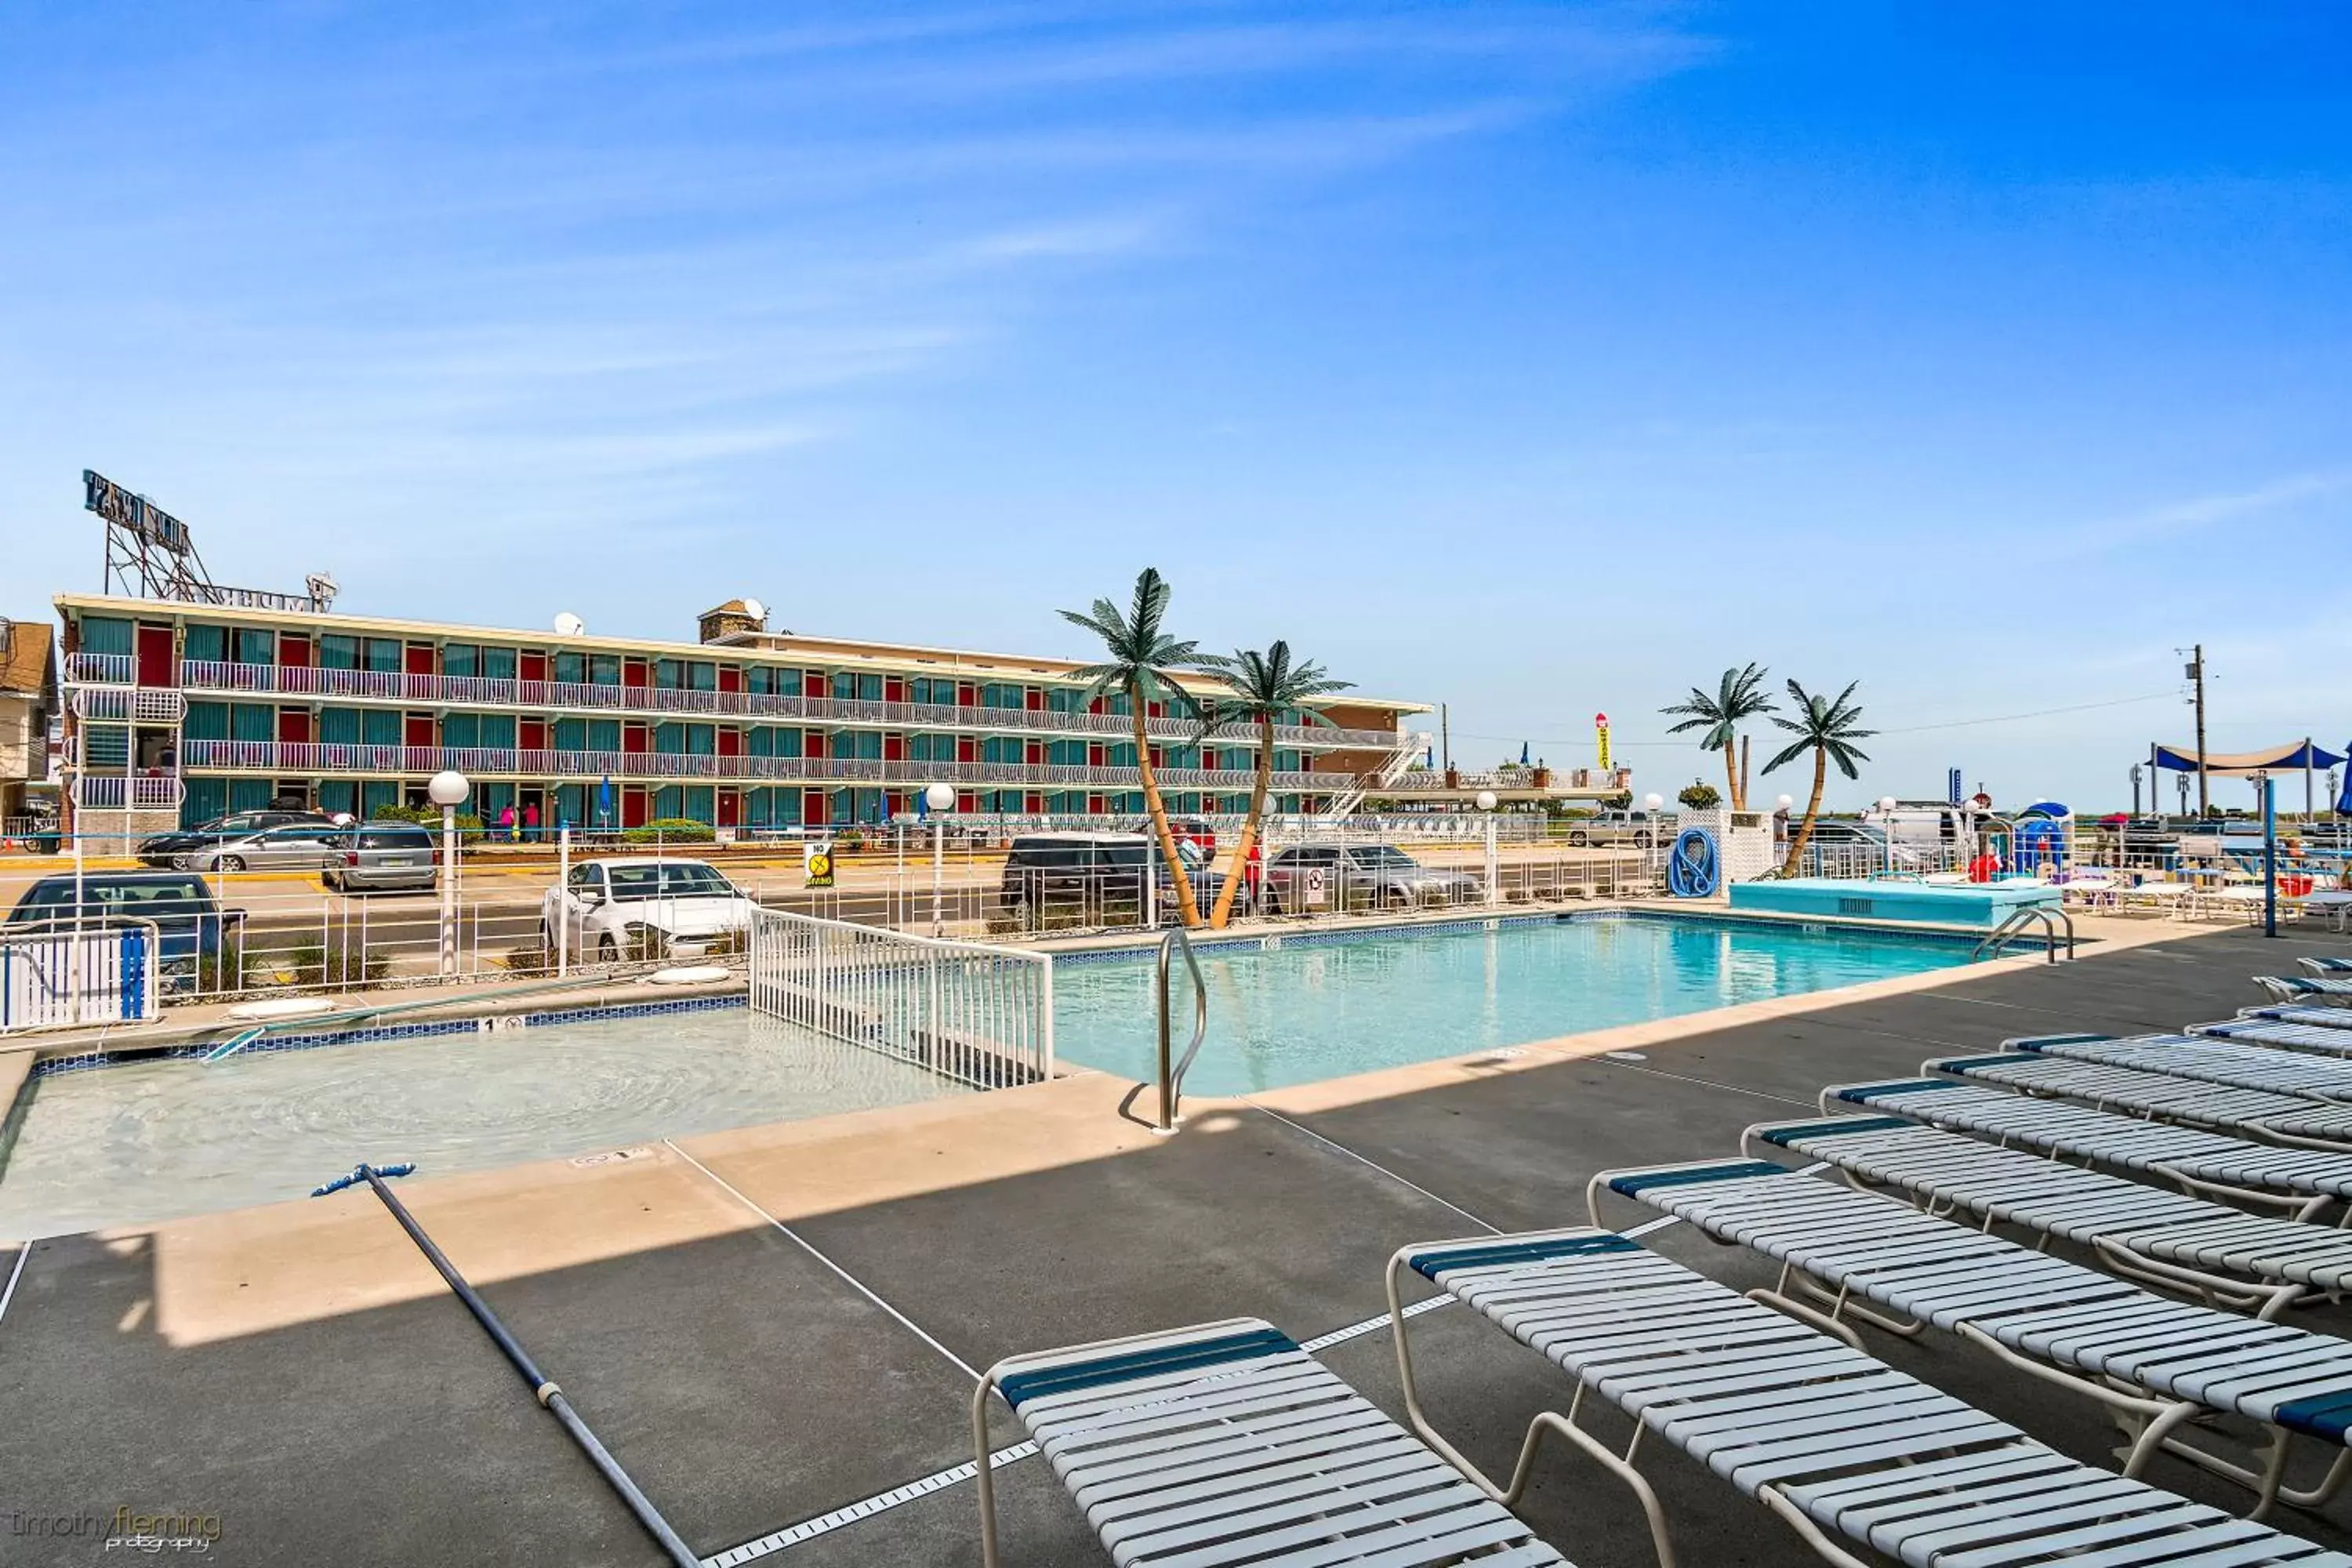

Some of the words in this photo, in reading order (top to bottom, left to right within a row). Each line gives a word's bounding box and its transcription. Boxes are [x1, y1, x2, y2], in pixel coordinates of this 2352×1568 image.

[2176, 774, 2190, 792] R
[813, 844, 824, 853] NO
[485, 1018, 494, 1033] 1
